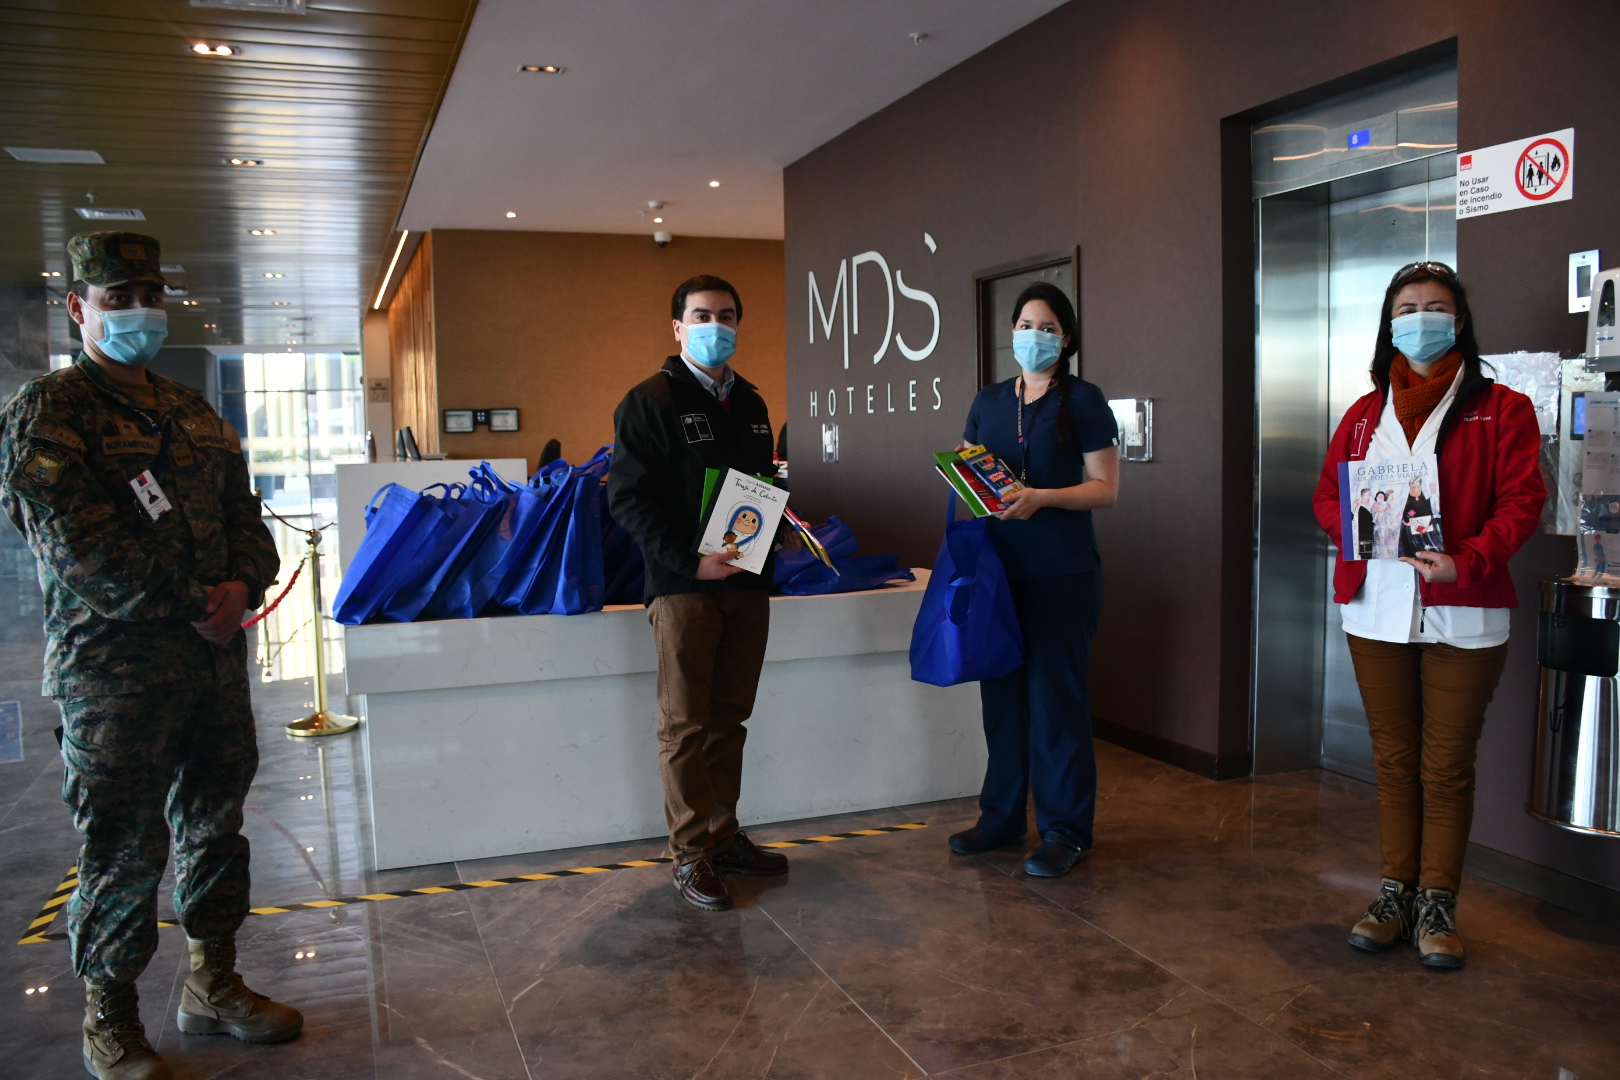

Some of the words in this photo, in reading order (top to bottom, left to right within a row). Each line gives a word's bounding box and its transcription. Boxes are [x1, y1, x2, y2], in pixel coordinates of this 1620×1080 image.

[1352, 134, 1358, 144] 8
[1472, 176, 1489, 185] Usar
[1470, 186, 1489, 194] Caso
[1470, 192, 1502, 203] Incendio
[1466, 204, 1488, 213] Sismo
[810, 377, 942, 417] HOTELES
[1358, 462, 1428, 476] GABRIELA
